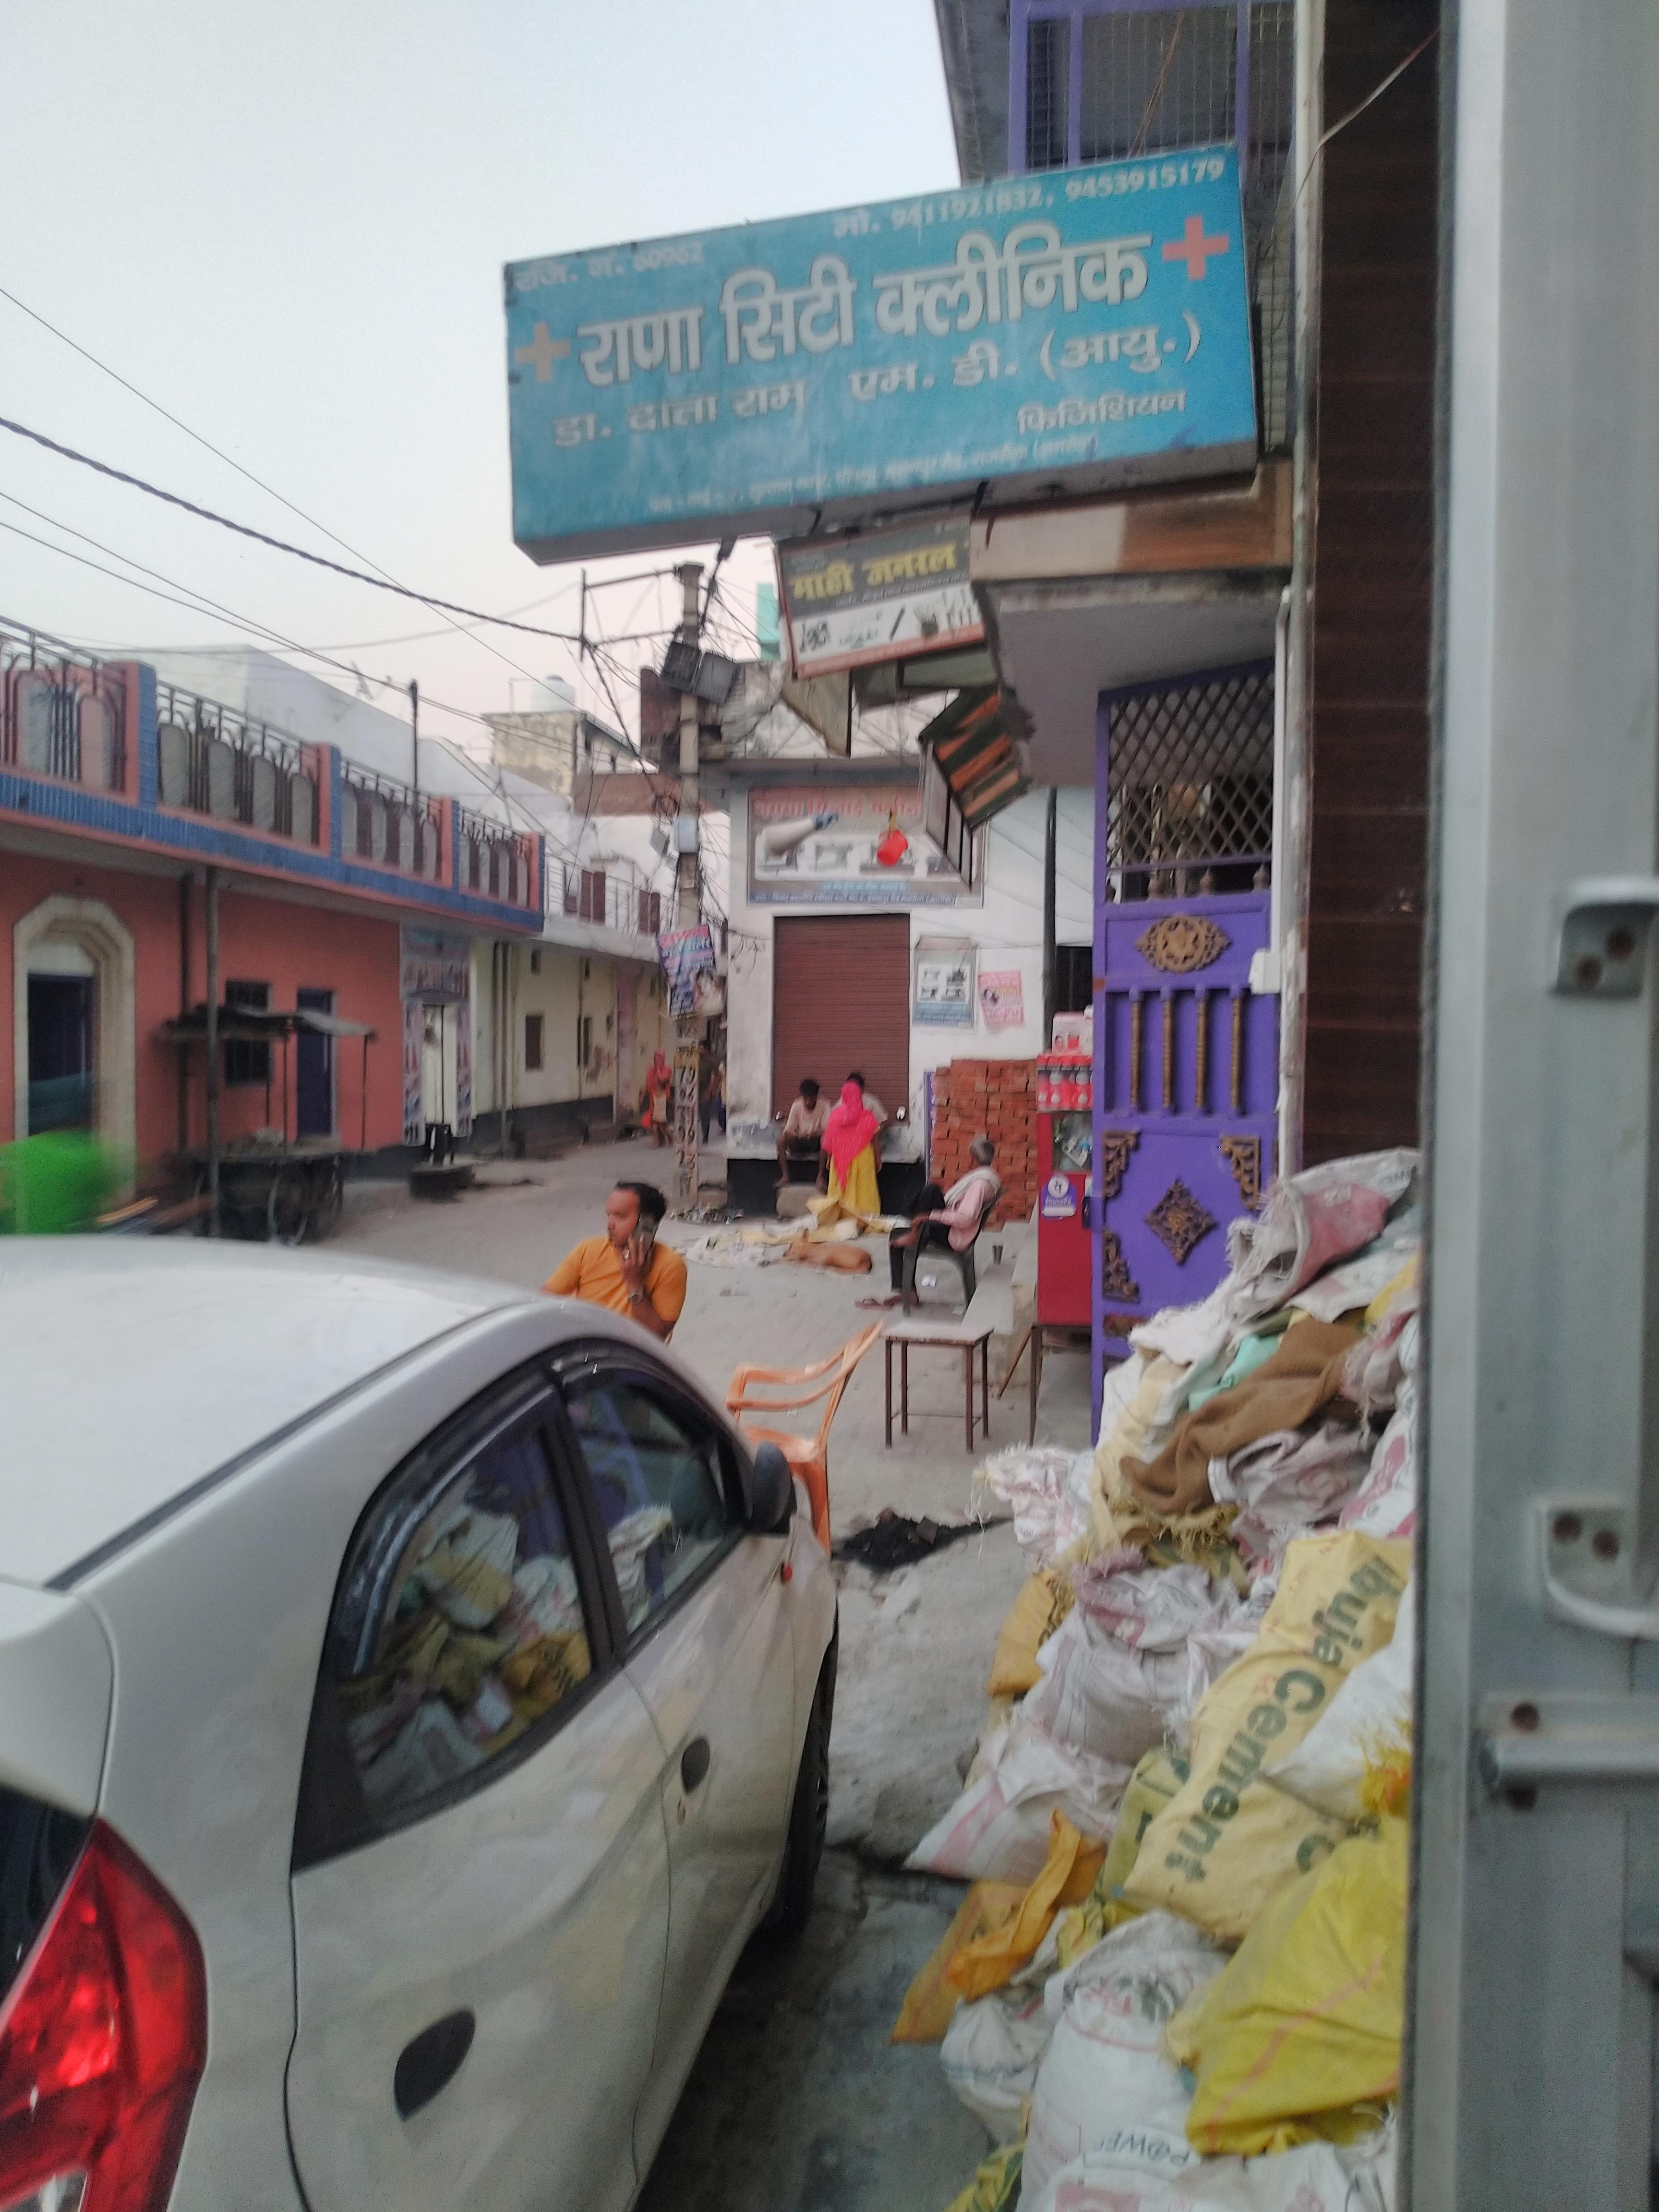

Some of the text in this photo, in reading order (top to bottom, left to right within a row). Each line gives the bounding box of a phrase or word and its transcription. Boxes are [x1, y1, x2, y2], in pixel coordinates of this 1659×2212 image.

[578, 221, 1152, 387] राणा सिटी क्लीनिक
[849, 363, 935, 401] एम.
[952, 339, 1018, 386] डी.
[1016, 388, 1187, 436] फिजिशियन
[1165, 1669, 1326, 1883] Cement
